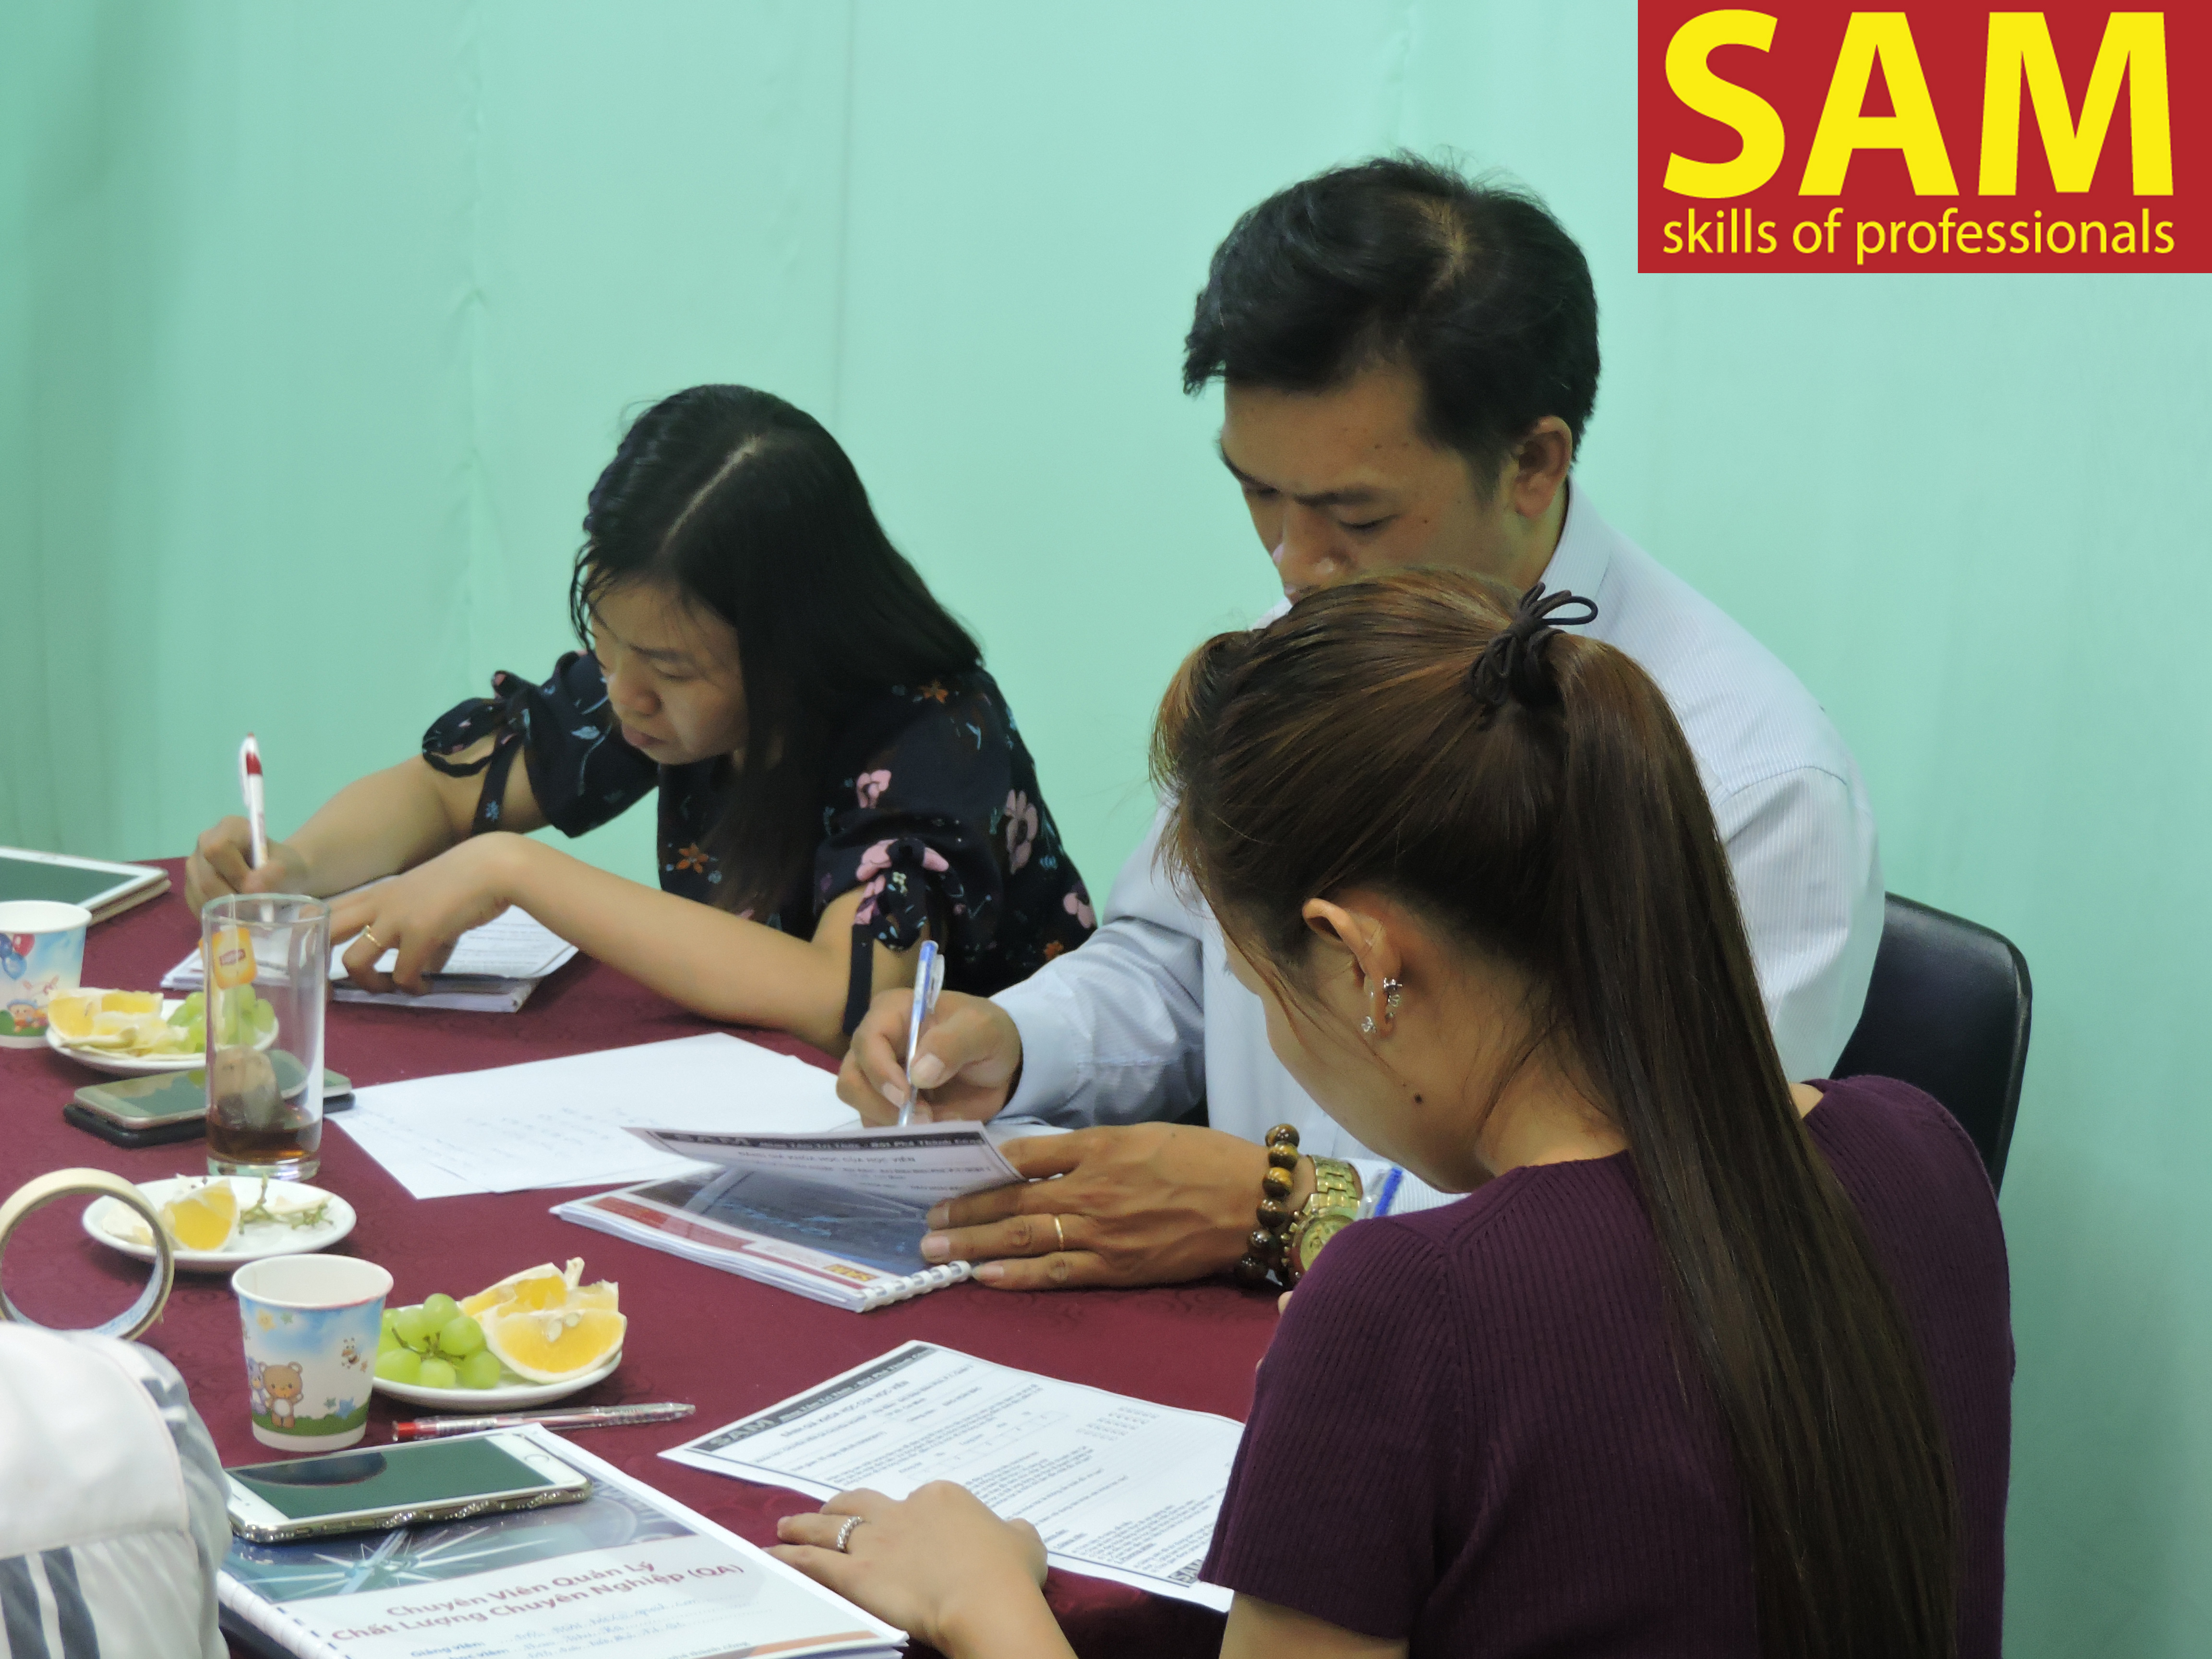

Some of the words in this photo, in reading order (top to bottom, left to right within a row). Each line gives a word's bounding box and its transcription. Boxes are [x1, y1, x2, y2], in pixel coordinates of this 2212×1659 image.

[710, 1419, 780, 1446] SAM
[332, 1623, 398, 1640] Chất
[398, 1612, 489, 1630] Lượng
[489, 1591, 589, 1616] Chuyên
[590, 1573, 685, 1594] Nghiệp
[687, 1563, 745, 1578] (QA)
[387, 1595, 488, 1616] Chuyên
[487, 1583, 550, 1600] Viên
[552, 1568, 623, 1586] Quản
[624, 1561, 655, 1572] Lý
